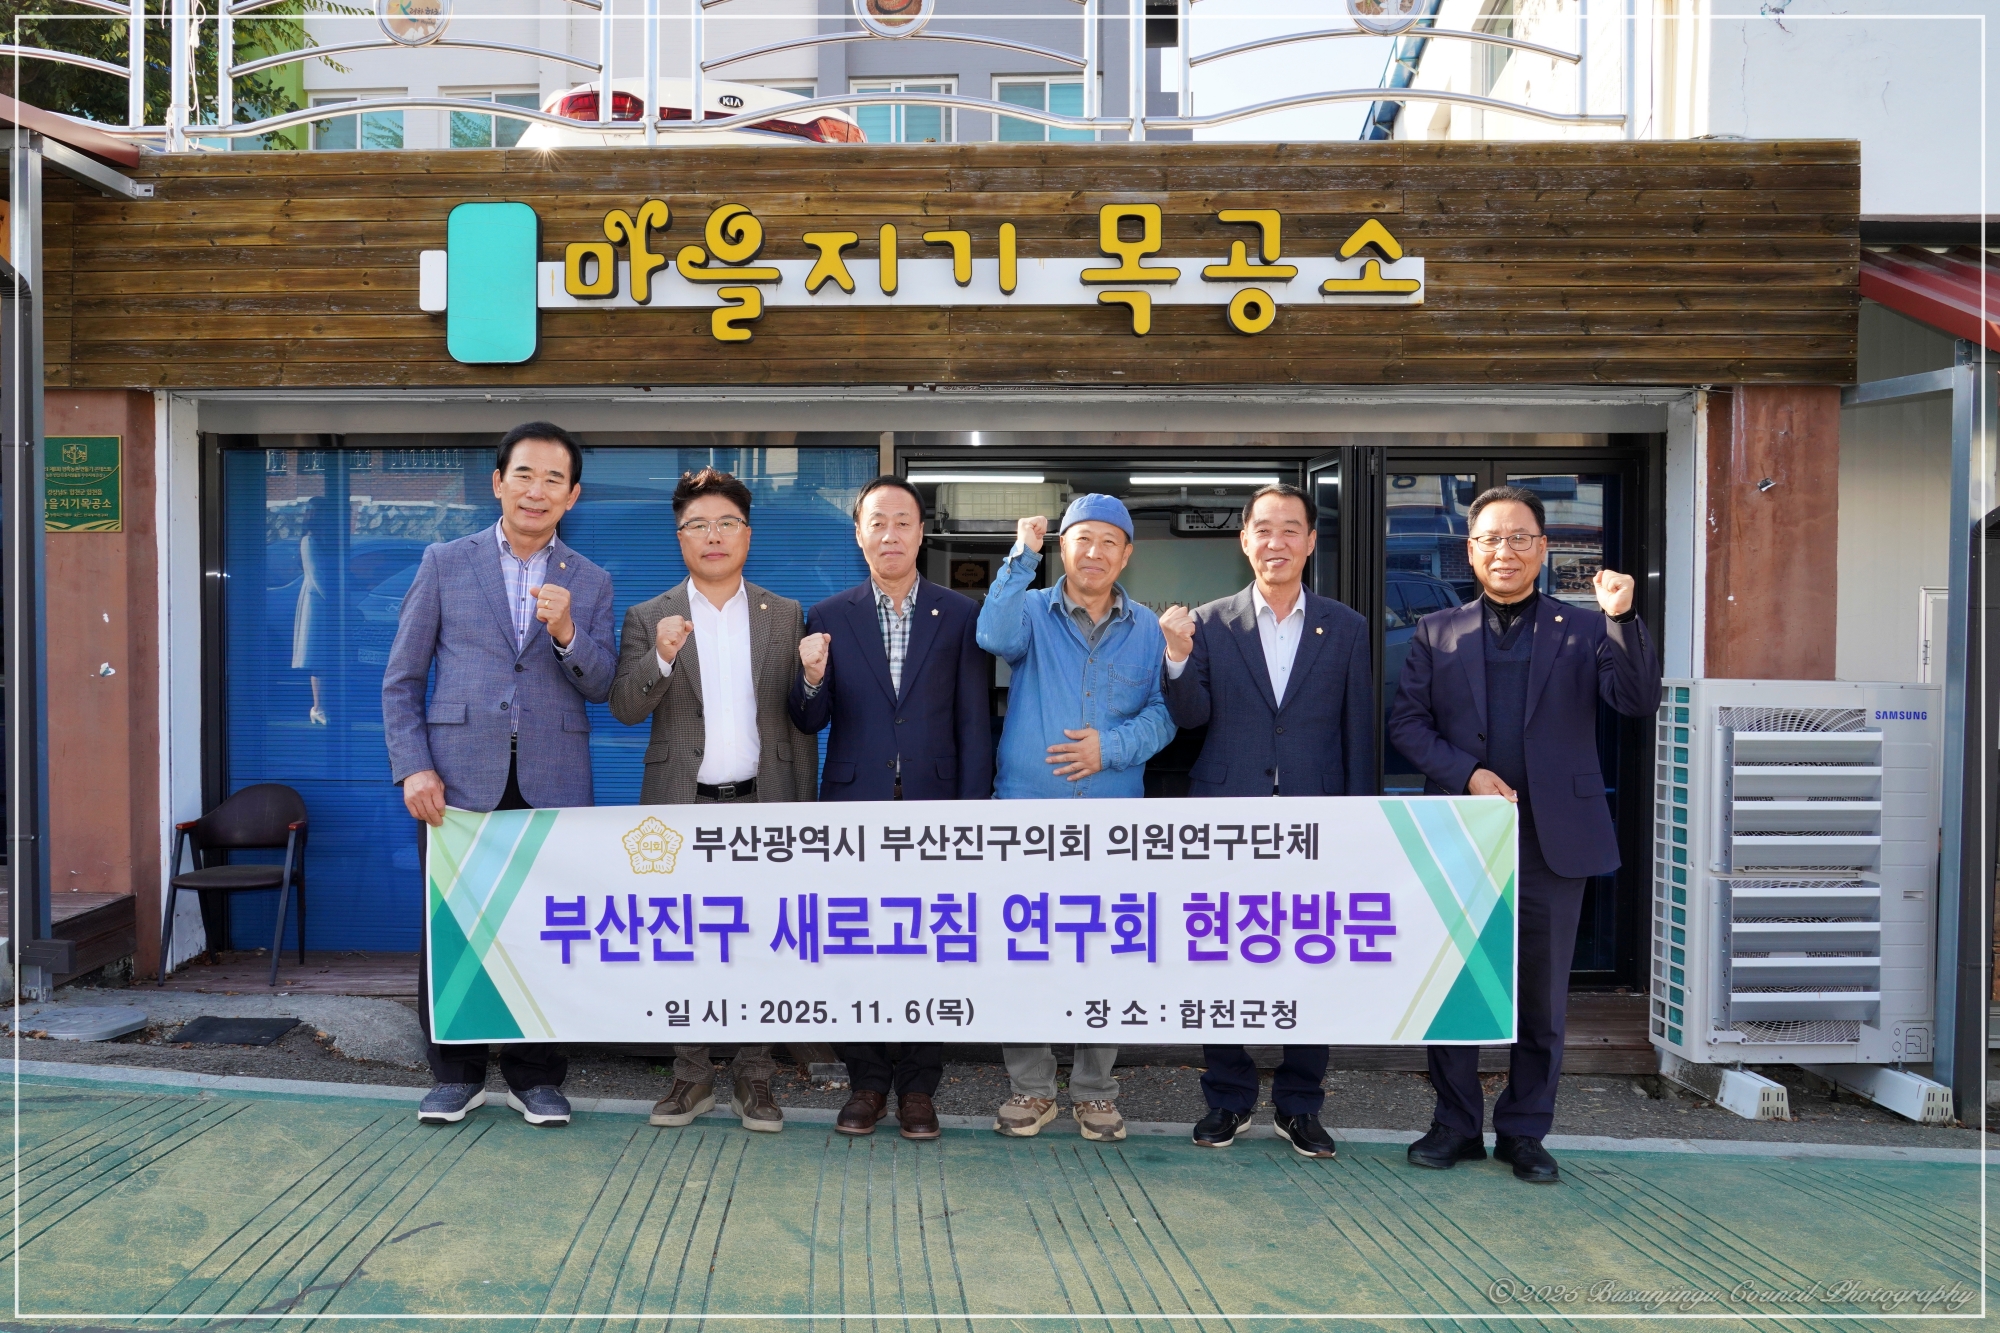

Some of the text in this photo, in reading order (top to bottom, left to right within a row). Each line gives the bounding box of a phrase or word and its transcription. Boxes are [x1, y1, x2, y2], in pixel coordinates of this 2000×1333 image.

[722, 96, 742, 107] KIA
[565, 199, 1420, 342] 마을지기 목공소
[1875, 710, 1928, 720] SAMSUNG
[641, 840, 663, 853] 의회
[692, 822, 1319, 863] 부산광역시 부산진구의회 의원연구단체
[540, 891, 1397, 965] 부산진구 새로고침 연구회 현장방문
[760, 1000, 837, 1024] 2025.
[905, 997, 974, 1027] 6(목)
[1179, 999, 1297, 1030] 합천군청
